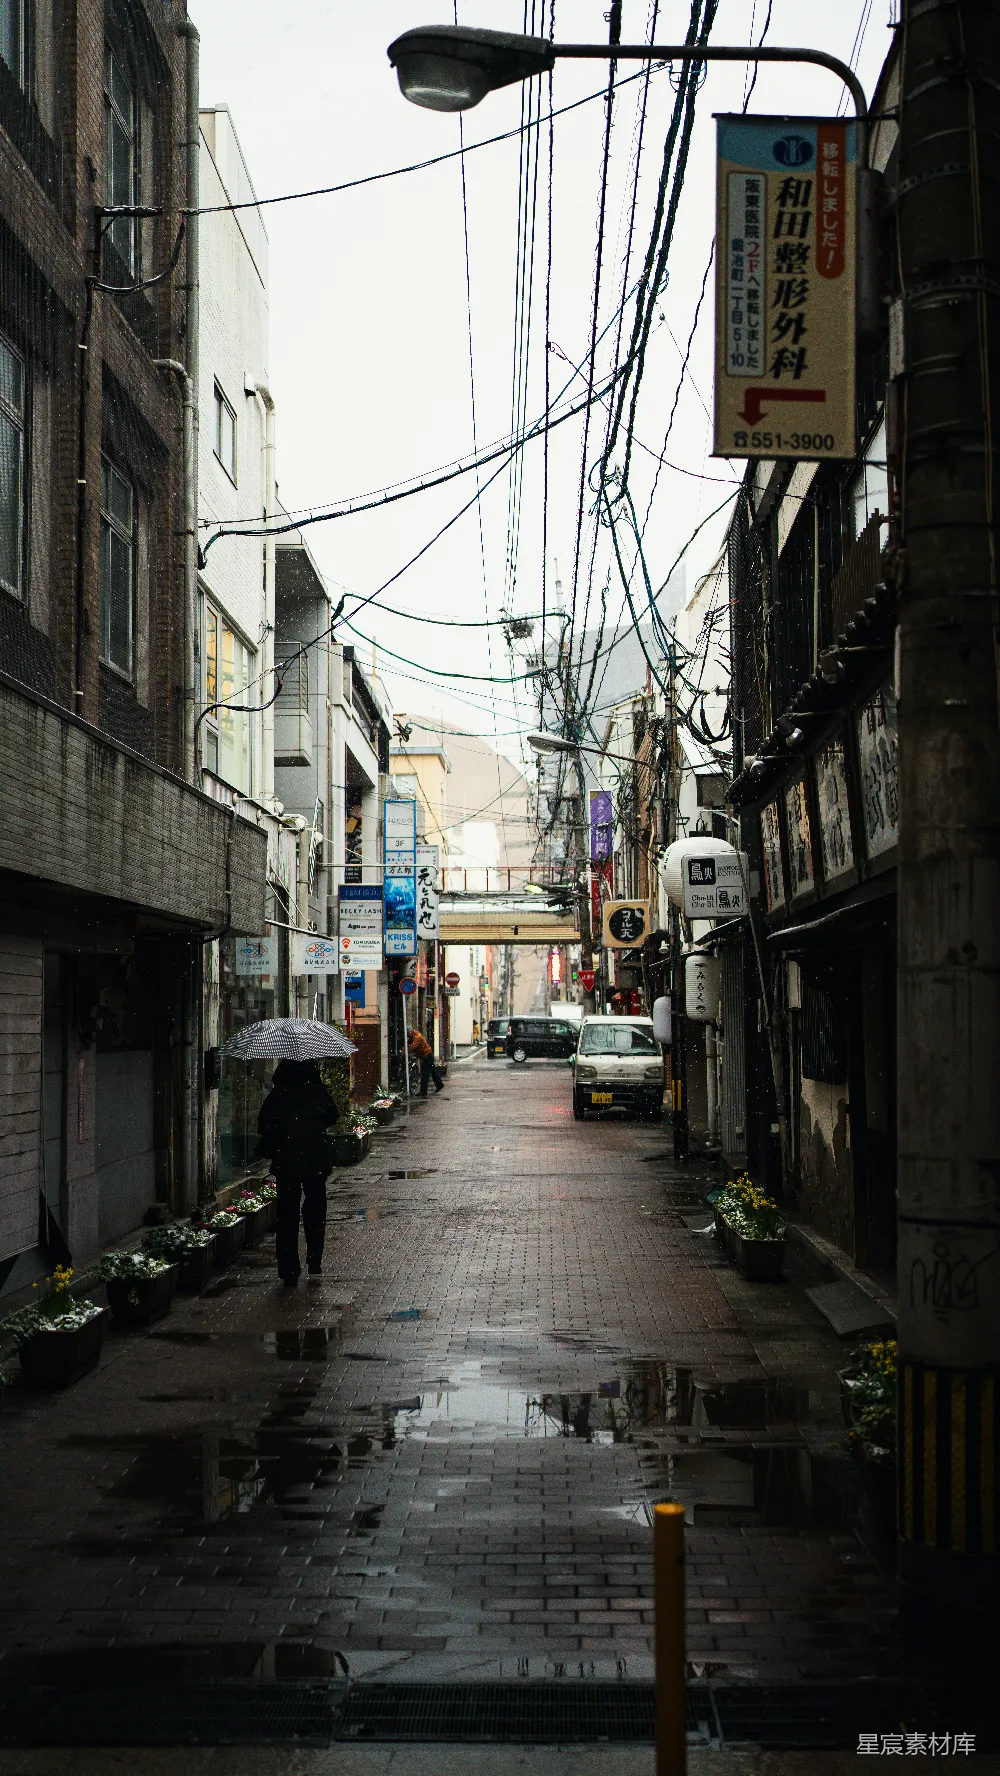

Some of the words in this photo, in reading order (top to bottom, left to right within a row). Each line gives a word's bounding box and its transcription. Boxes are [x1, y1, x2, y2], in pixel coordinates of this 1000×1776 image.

[769, 176, 812, 379] 和田整形外科
[752, 432, 834, 450] 551-3900
